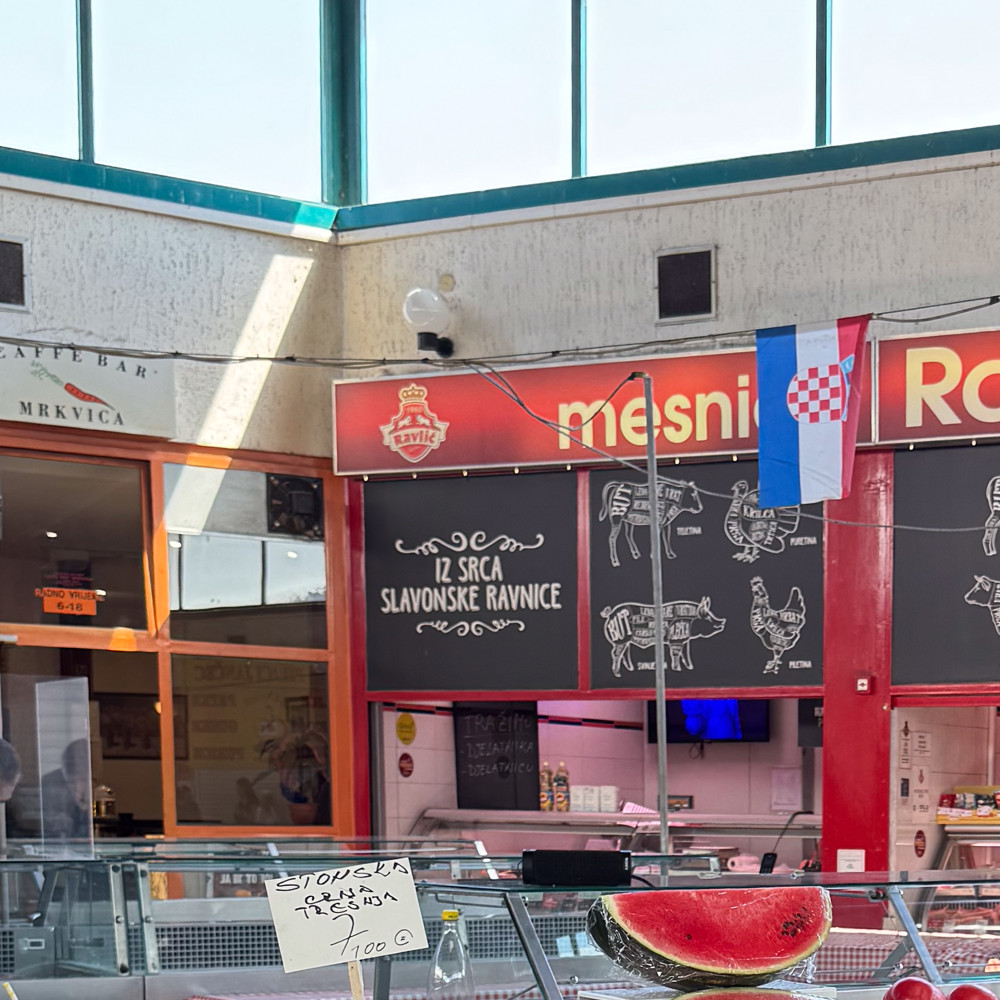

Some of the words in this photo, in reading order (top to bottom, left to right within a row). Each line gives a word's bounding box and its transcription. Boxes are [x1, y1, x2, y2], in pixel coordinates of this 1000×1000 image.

[98, 354, 147, 379] BAR
[19, 401, 125, 426] MRKVICA
[558, 374, 759, 451] mesni
[611, 484, 632, 517] BUT
[435, 557, 452, 583] IZ
[458, 555, 503, 583] SRCA
[380, 585, 480, 614] SLAVONSKE
[486, 582, 562, 611] RAVNICE
[608, 608, 632, 641] BUT
[276, 861, 409, 892] STONSKA
[305, 885, 374, 905] CRNA
